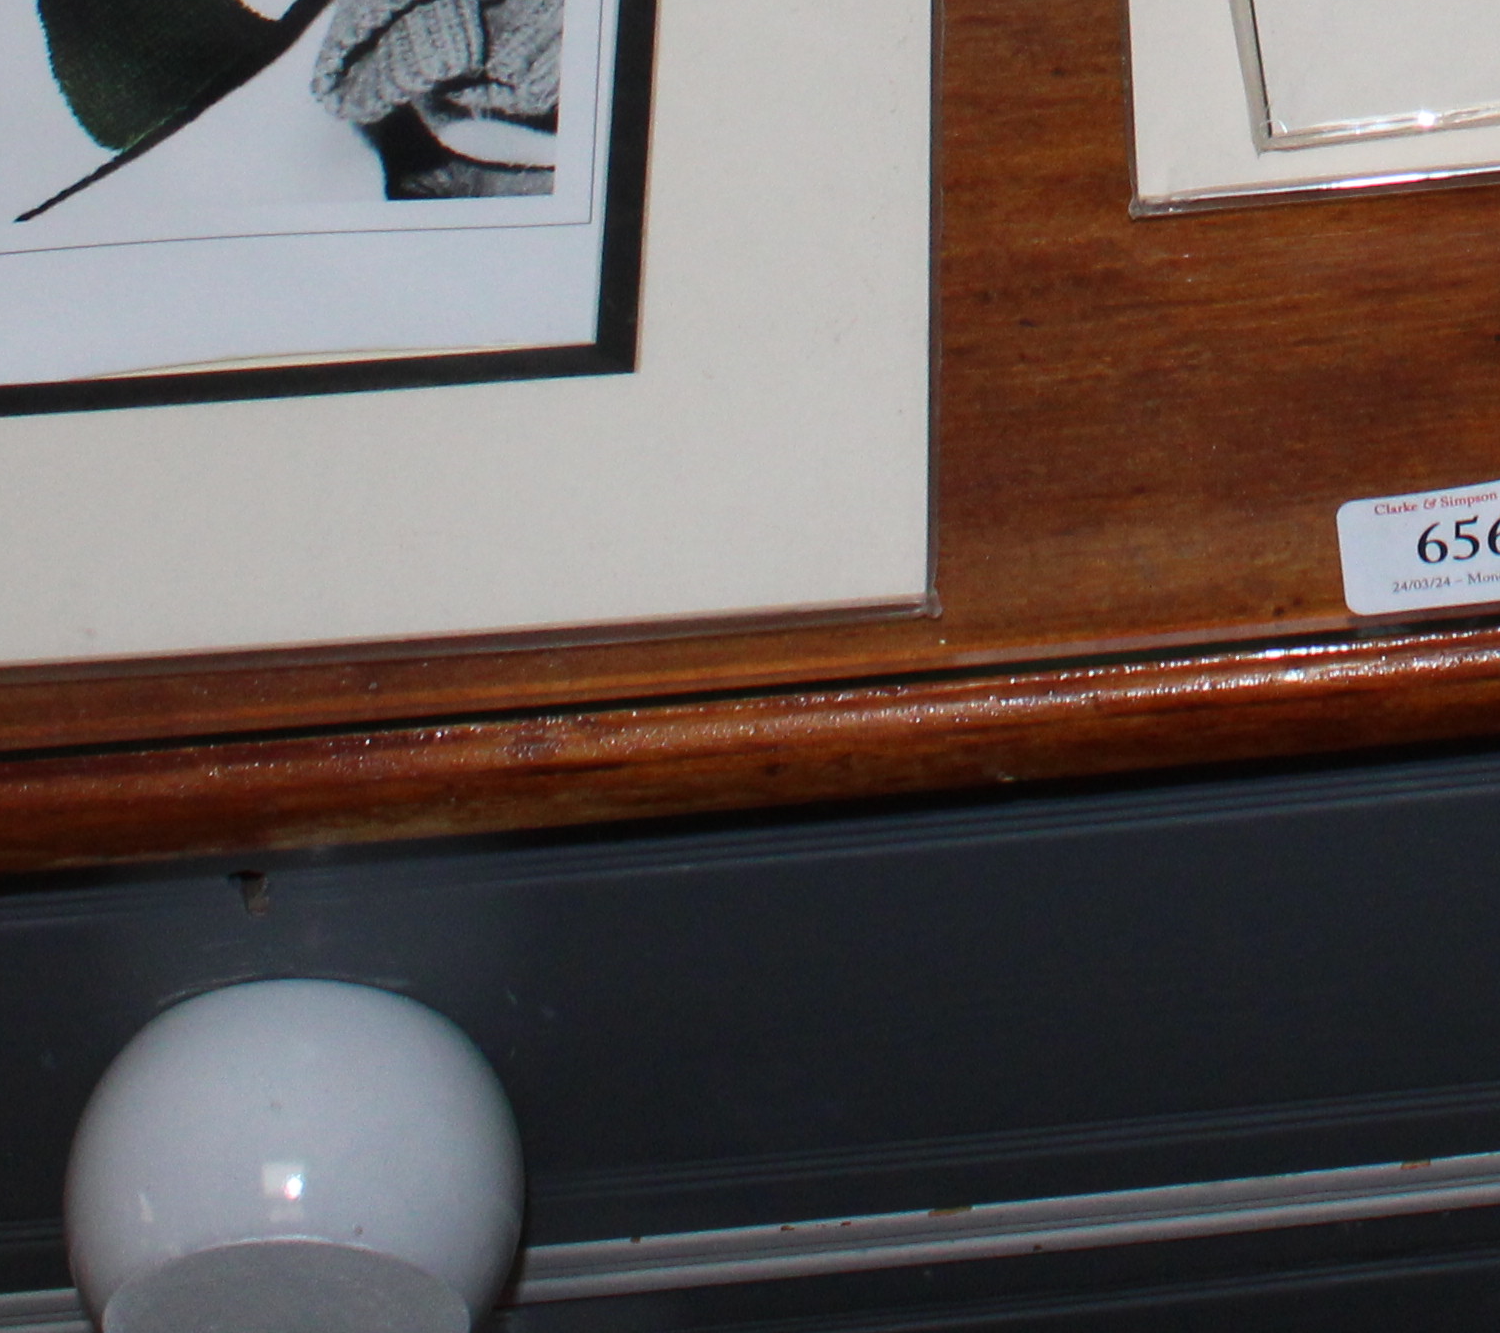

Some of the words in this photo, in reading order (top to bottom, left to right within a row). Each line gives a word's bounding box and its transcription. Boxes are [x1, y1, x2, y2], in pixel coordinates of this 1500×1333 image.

[1374, 502, 1418, 516] Clarke
[1423, 499, 1437, 511] &
[1440, 491, 1497, 508] Simpson
